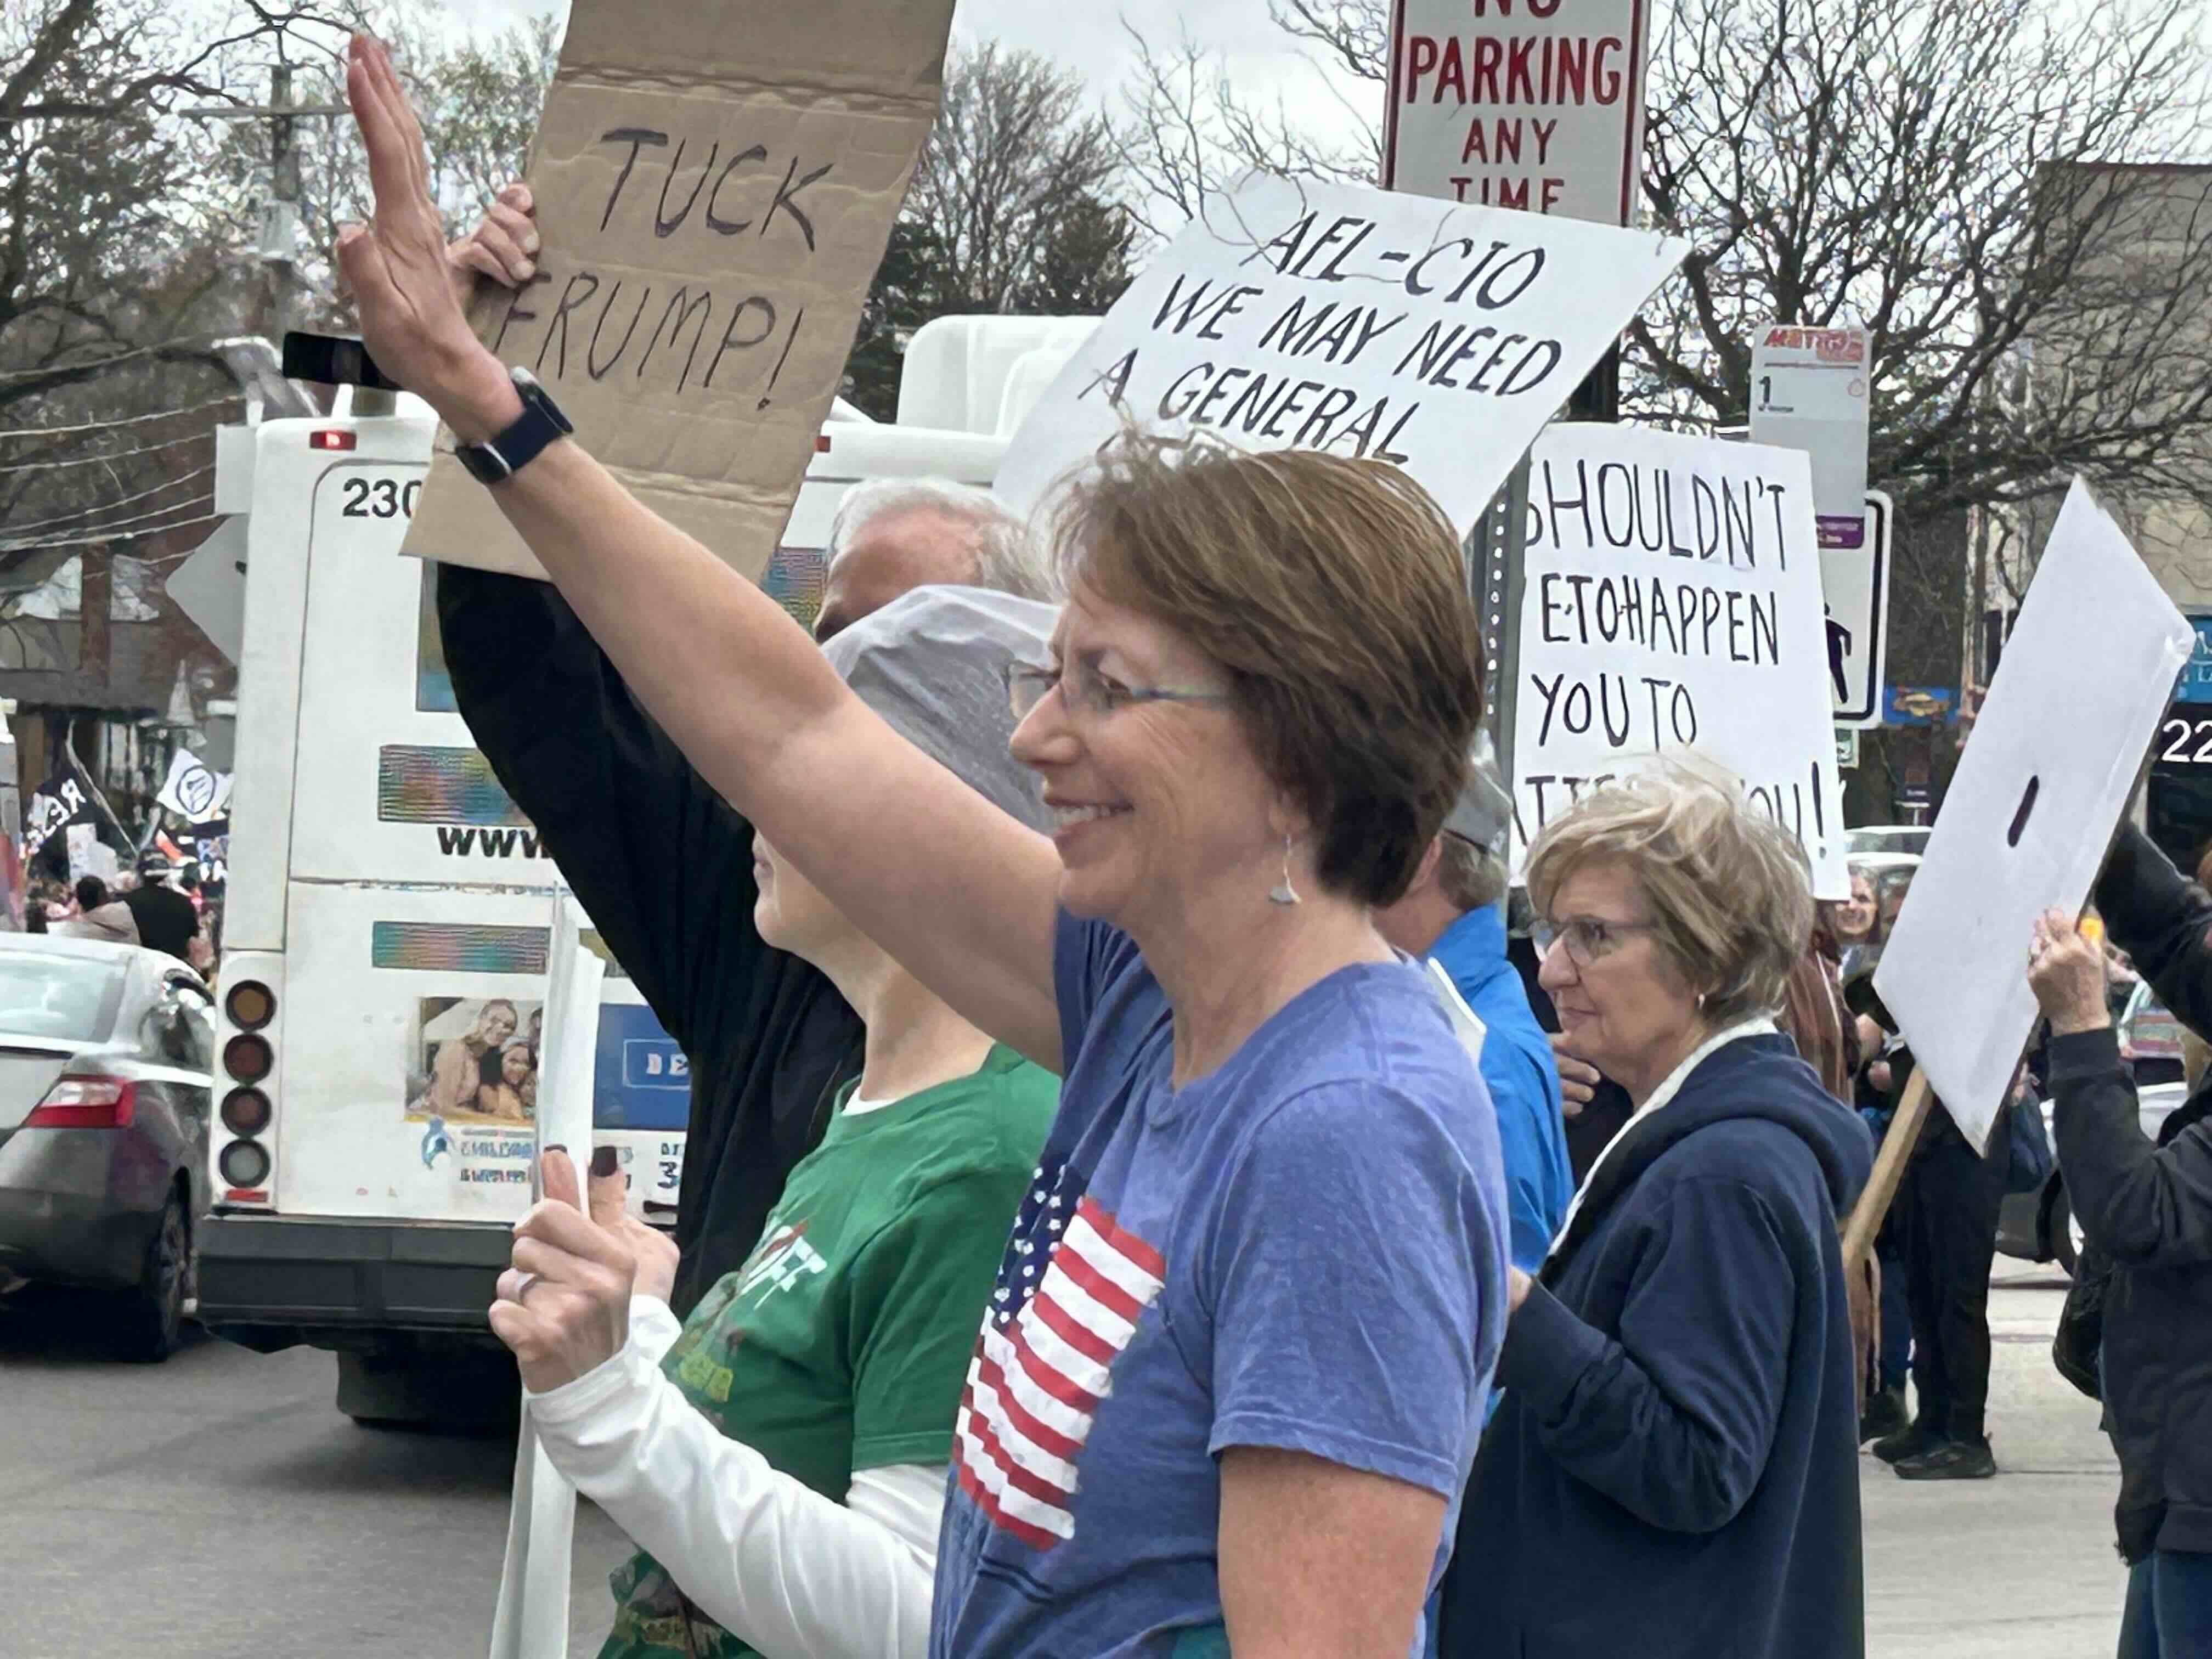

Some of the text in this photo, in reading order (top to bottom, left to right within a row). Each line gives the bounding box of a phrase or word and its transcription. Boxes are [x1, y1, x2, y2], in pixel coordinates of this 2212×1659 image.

[1406, 36, 1623, 106] PARKING
[600, 127, 834, 252] TUCK
[1462, 117, 1558, 165] ANY
[1238, 211, 1546, 311] AFL-CIO
[494, 272, 804, 411] FRUMP!
[1152, 273, 1563, 397] WE MAY NEED
[1077, 348, 1421, 465] A GENERAL
[1531, 673, 1697, 752] YOU TO
